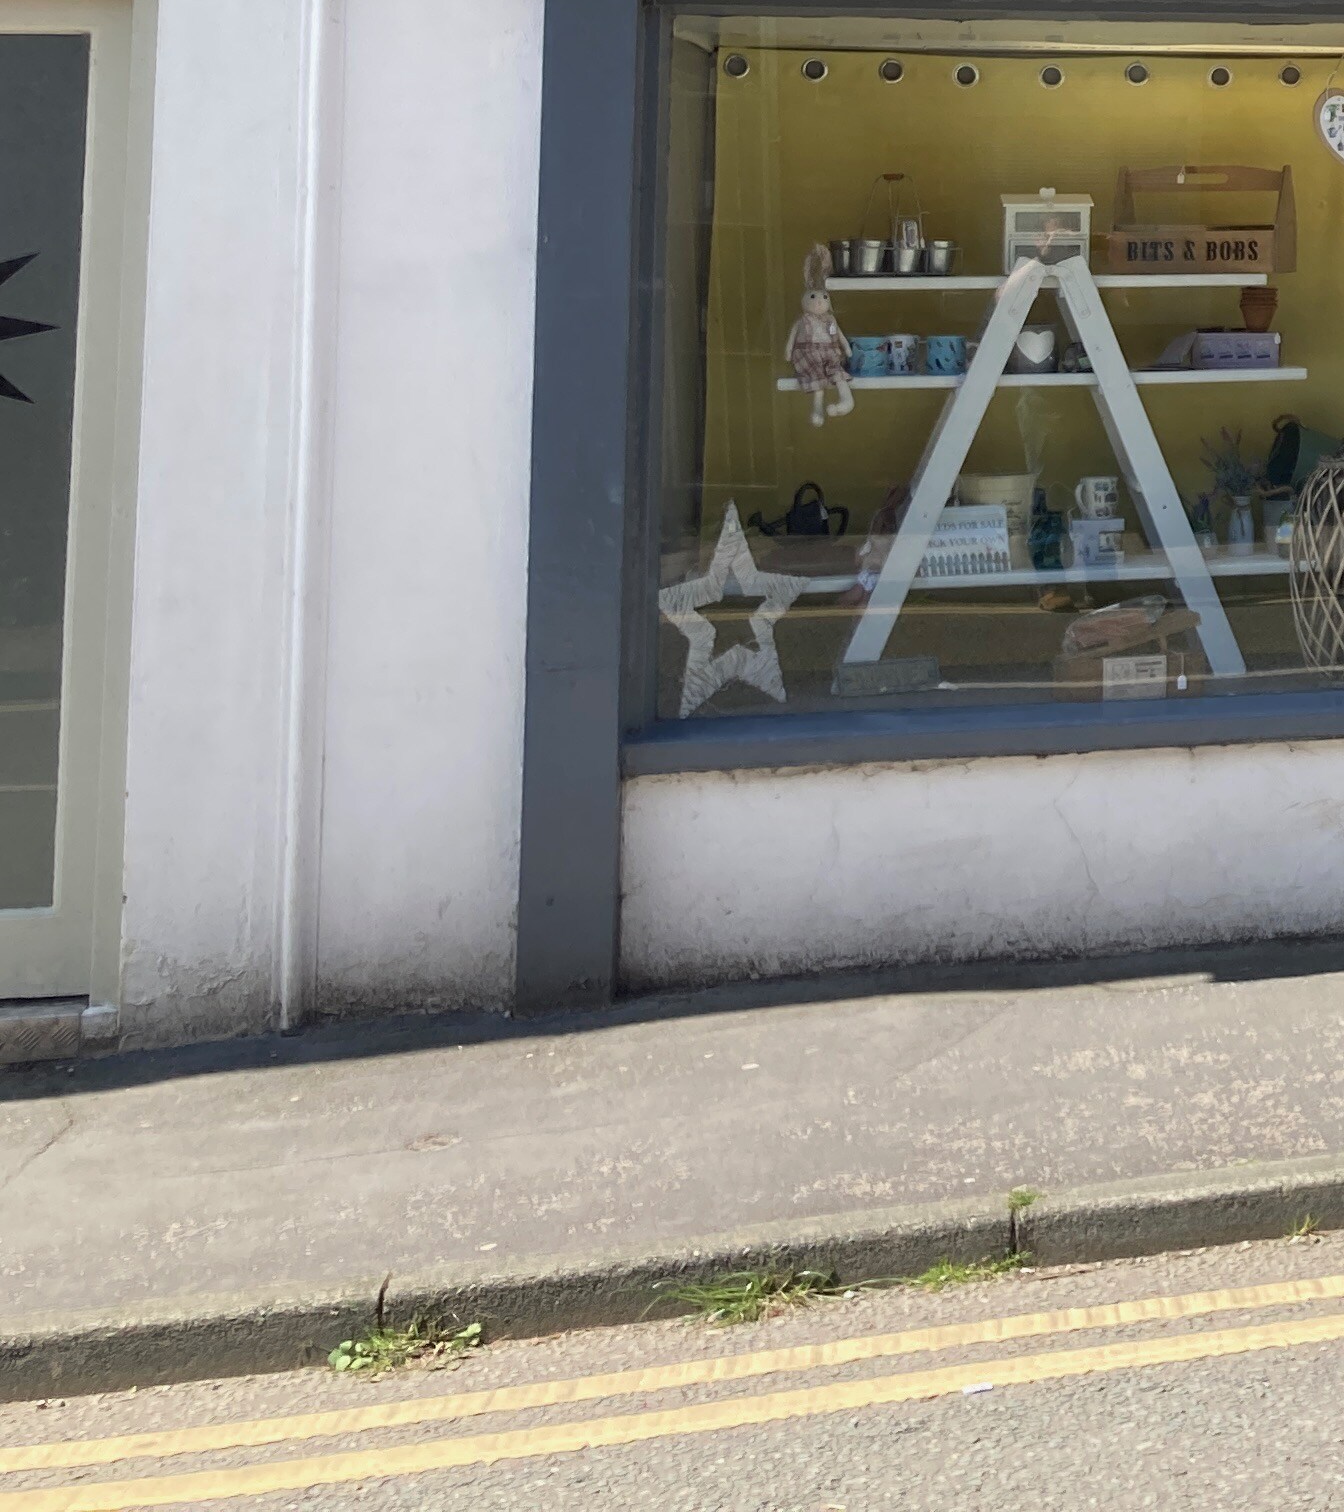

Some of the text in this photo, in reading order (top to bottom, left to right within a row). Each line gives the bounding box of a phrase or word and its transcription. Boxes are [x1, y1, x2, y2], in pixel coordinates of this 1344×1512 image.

[1126, 240, 1259, 262] BITS & BOBS
